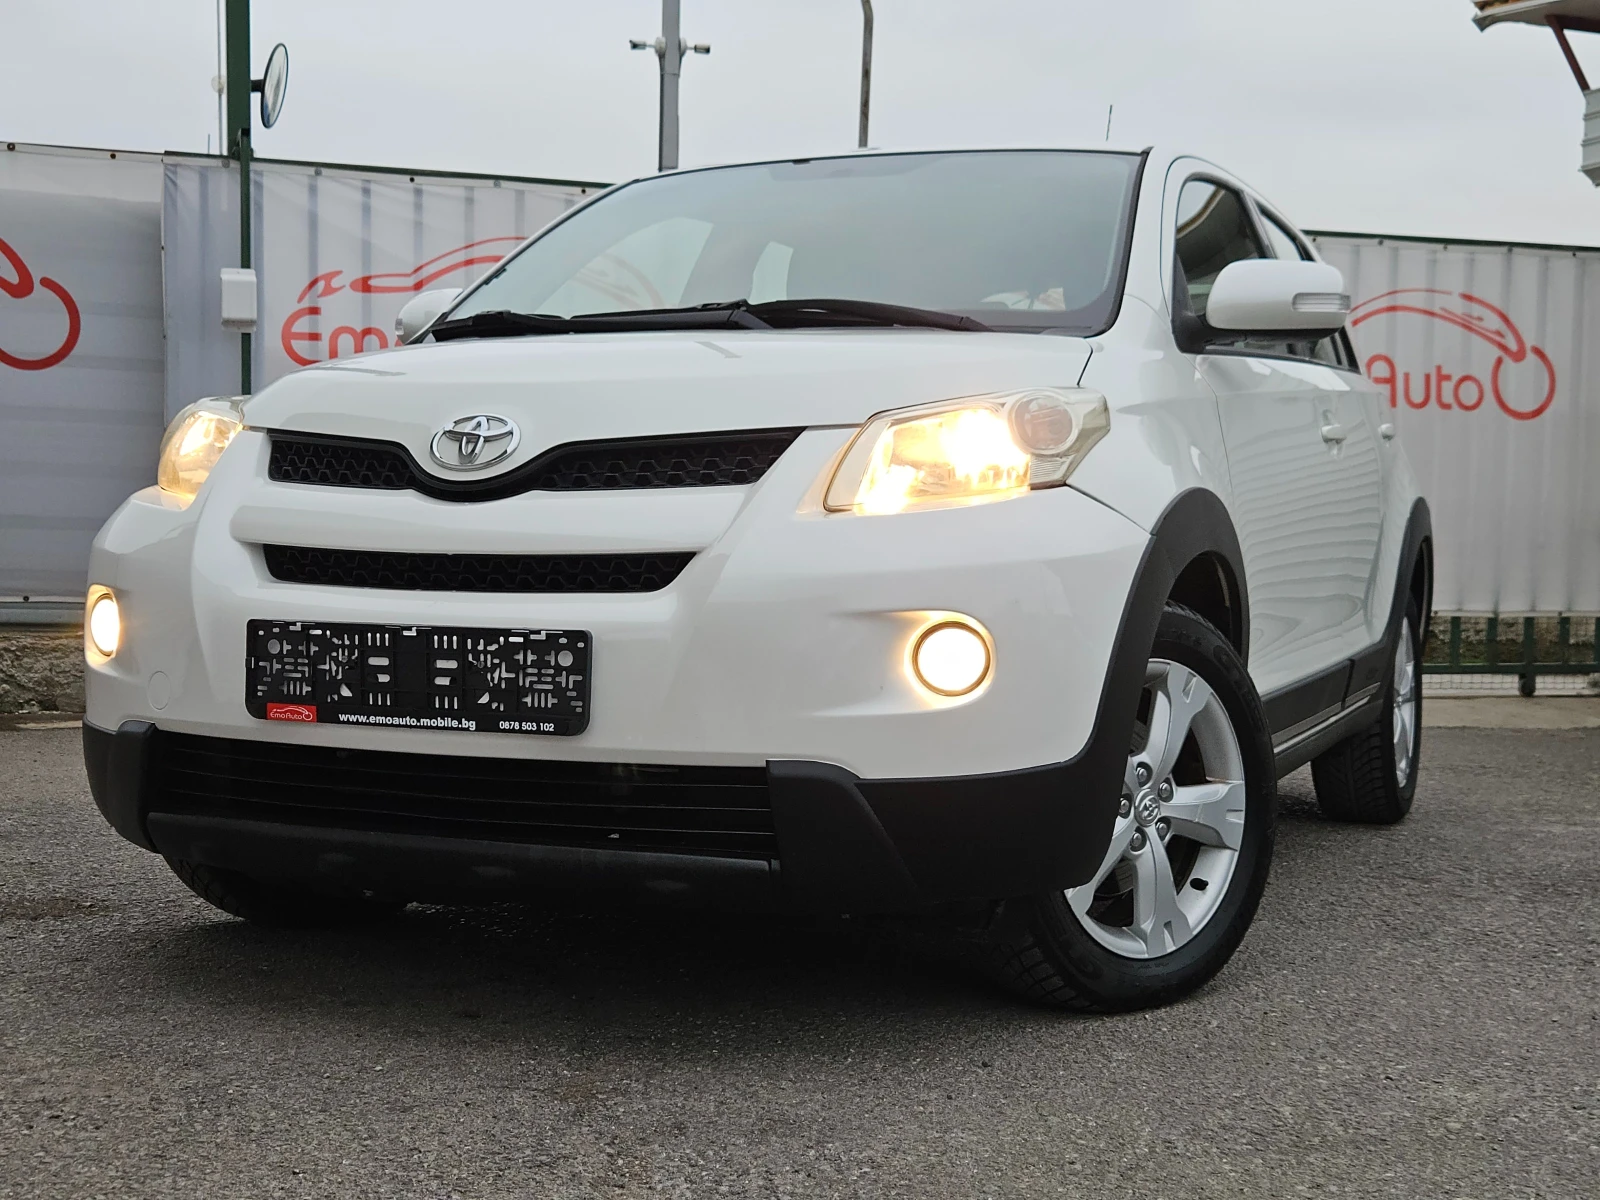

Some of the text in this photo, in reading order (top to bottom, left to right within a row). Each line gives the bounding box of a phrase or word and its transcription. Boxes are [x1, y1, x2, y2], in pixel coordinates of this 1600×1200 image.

[281, 306, 404, 367] Em
[1365, 354, 1484, 412] Auto
[338, 713, 476, 731] www.emoauto.mobile.bg
[499, 721, 555, 732] 0878 503 102
